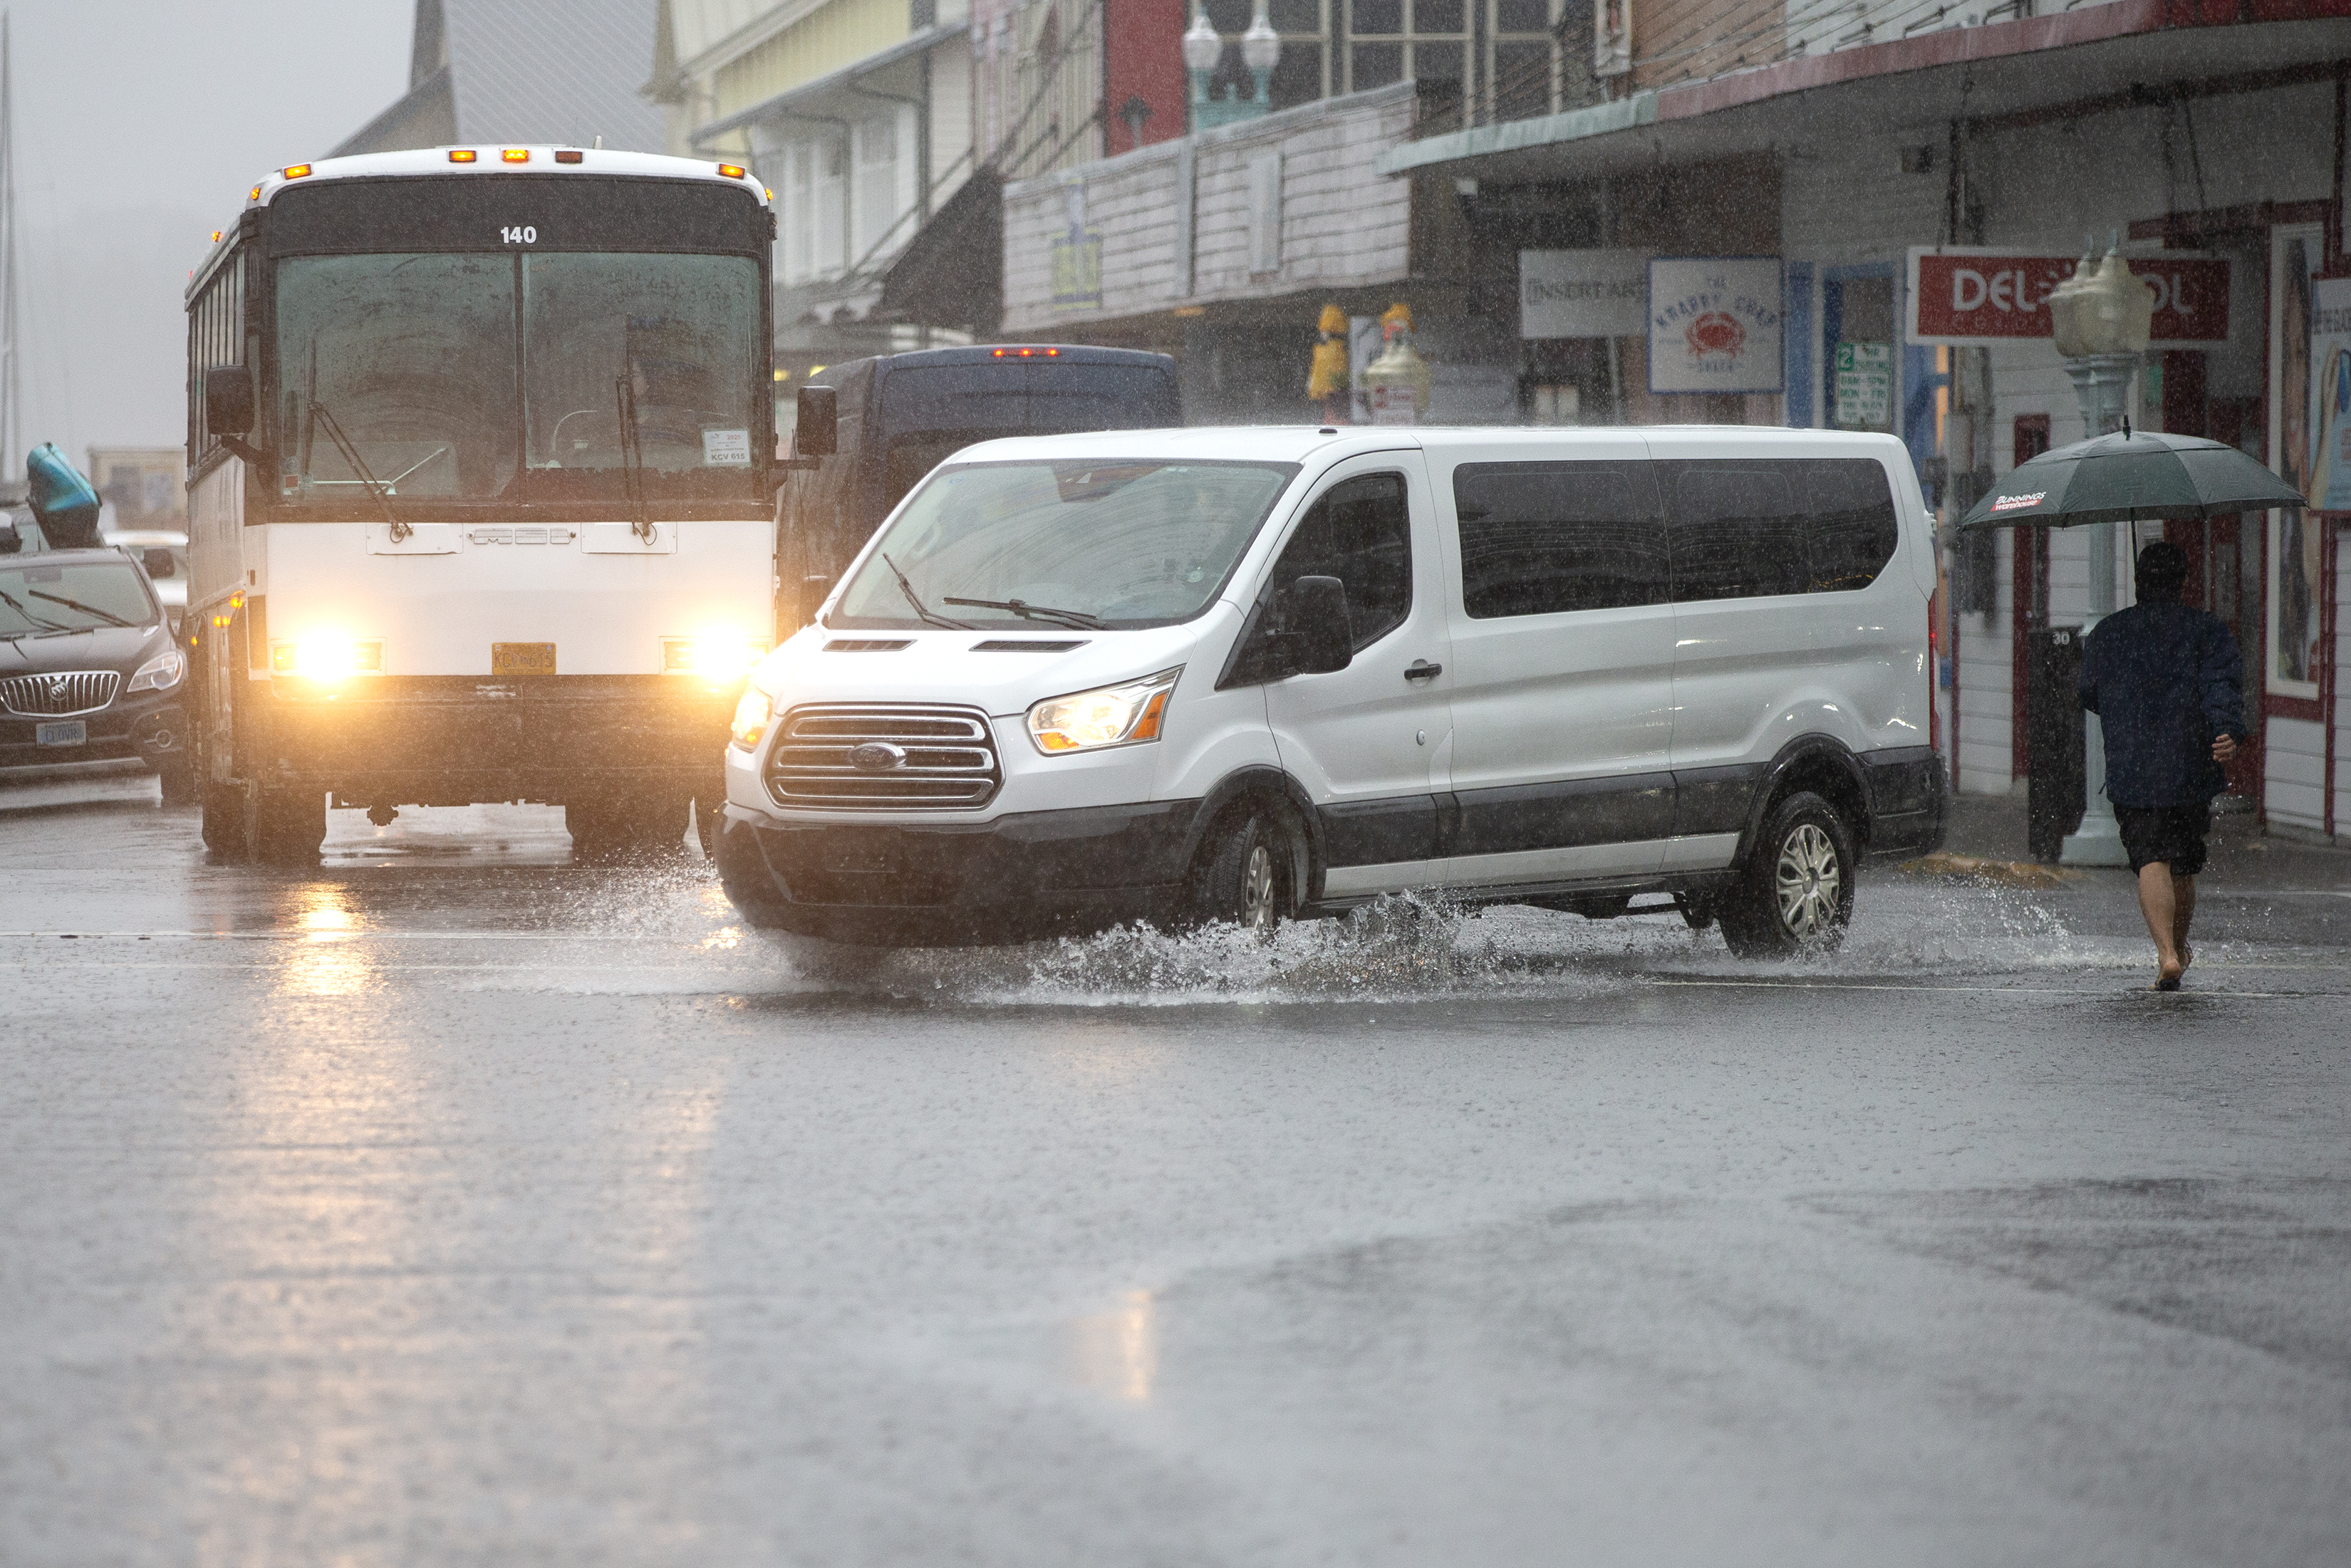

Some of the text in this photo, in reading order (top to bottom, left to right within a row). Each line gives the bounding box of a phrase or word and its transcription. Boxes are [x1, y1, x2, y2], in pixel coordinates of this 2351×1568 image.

[501, 226, 537, 244] 140
[1953, 269, 2037, 313] DEL
[1841, 347, 1852, 368] 2
[1996, 492, 2047, 504] BUNNINGS
[1996, 499, 2038, 510] warehouse
[2052, 630, 2070, 645] 30
[494, 652, 554, 668] KCV 615
[859, 748, 886, 763] Ford
